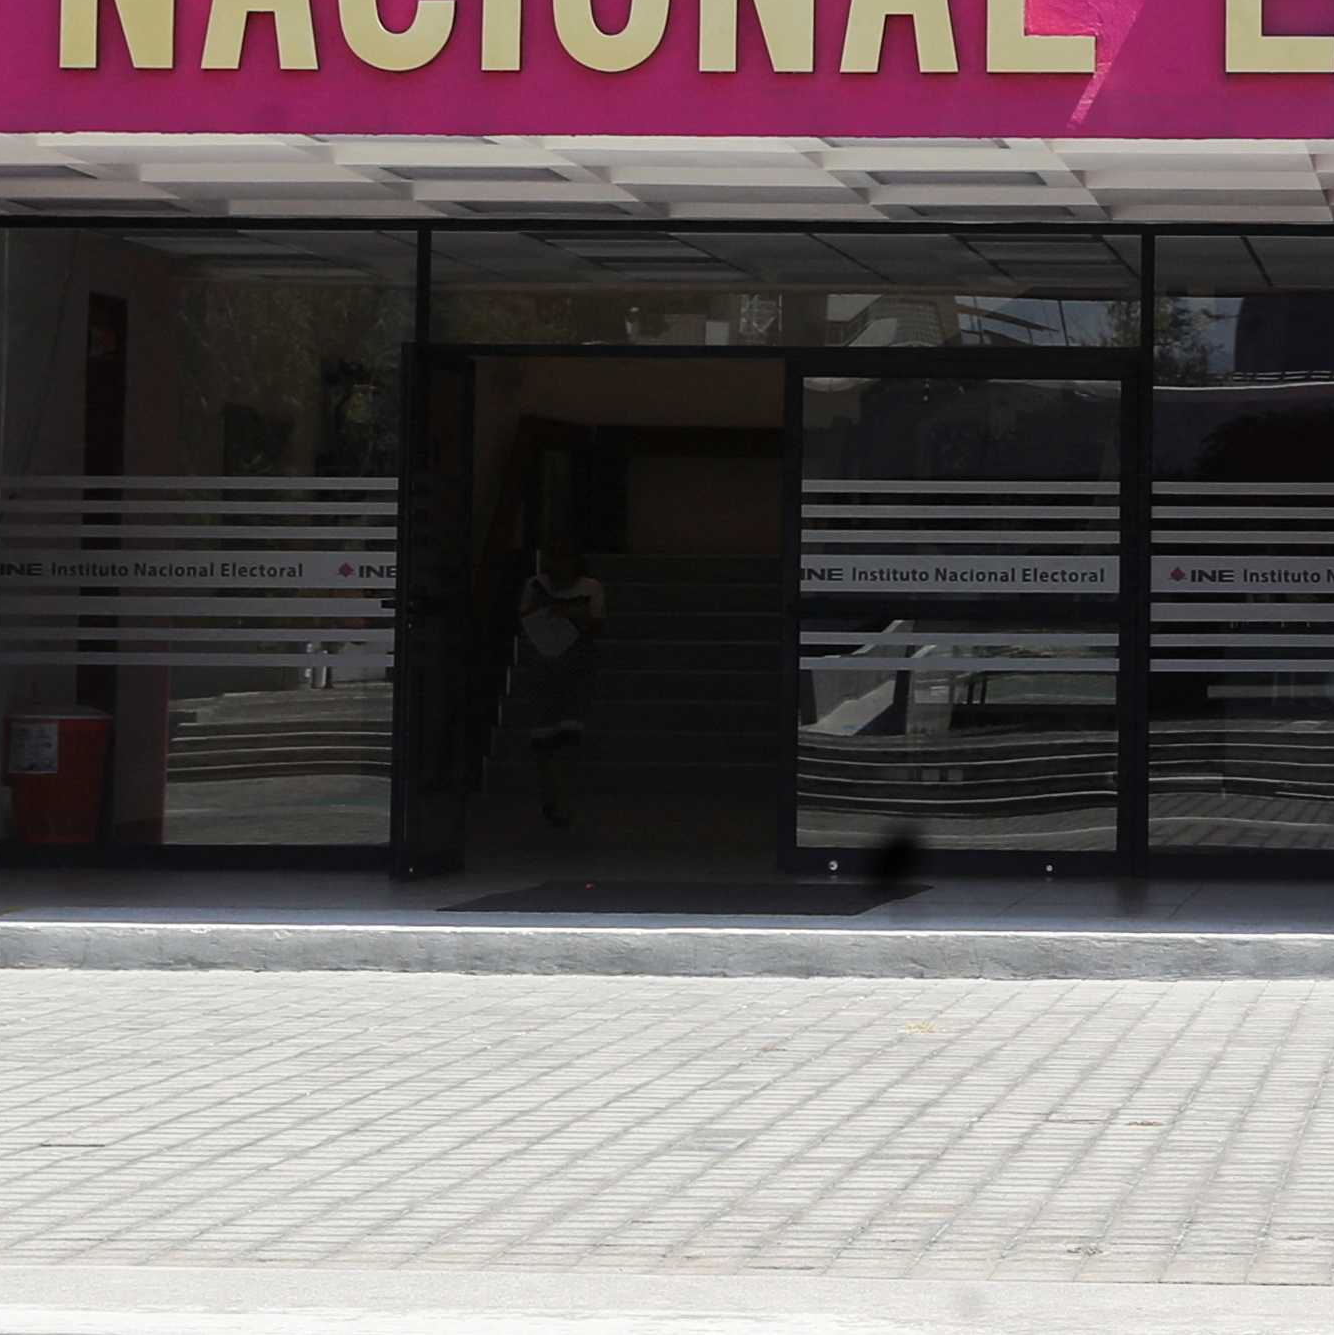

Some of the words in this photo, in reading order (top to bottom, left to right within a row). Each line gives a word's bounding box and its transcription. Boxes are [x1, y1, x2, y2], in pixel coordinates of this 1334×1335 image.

[51, 561, 130, 578] Instituto
[132, 561, 216, 578] Nacional
[220, 562, 303, 579] Electoral
[800, 568, 844, 581] INE
[852, 567, 930, 582] Instituto
[934, 567, 1016, 582] Nacional
[1021, 567, 1106, 583] Electoral
[1190, 569, 1234, 583] INE
[1243, 569, 1321, 584] Instituto
